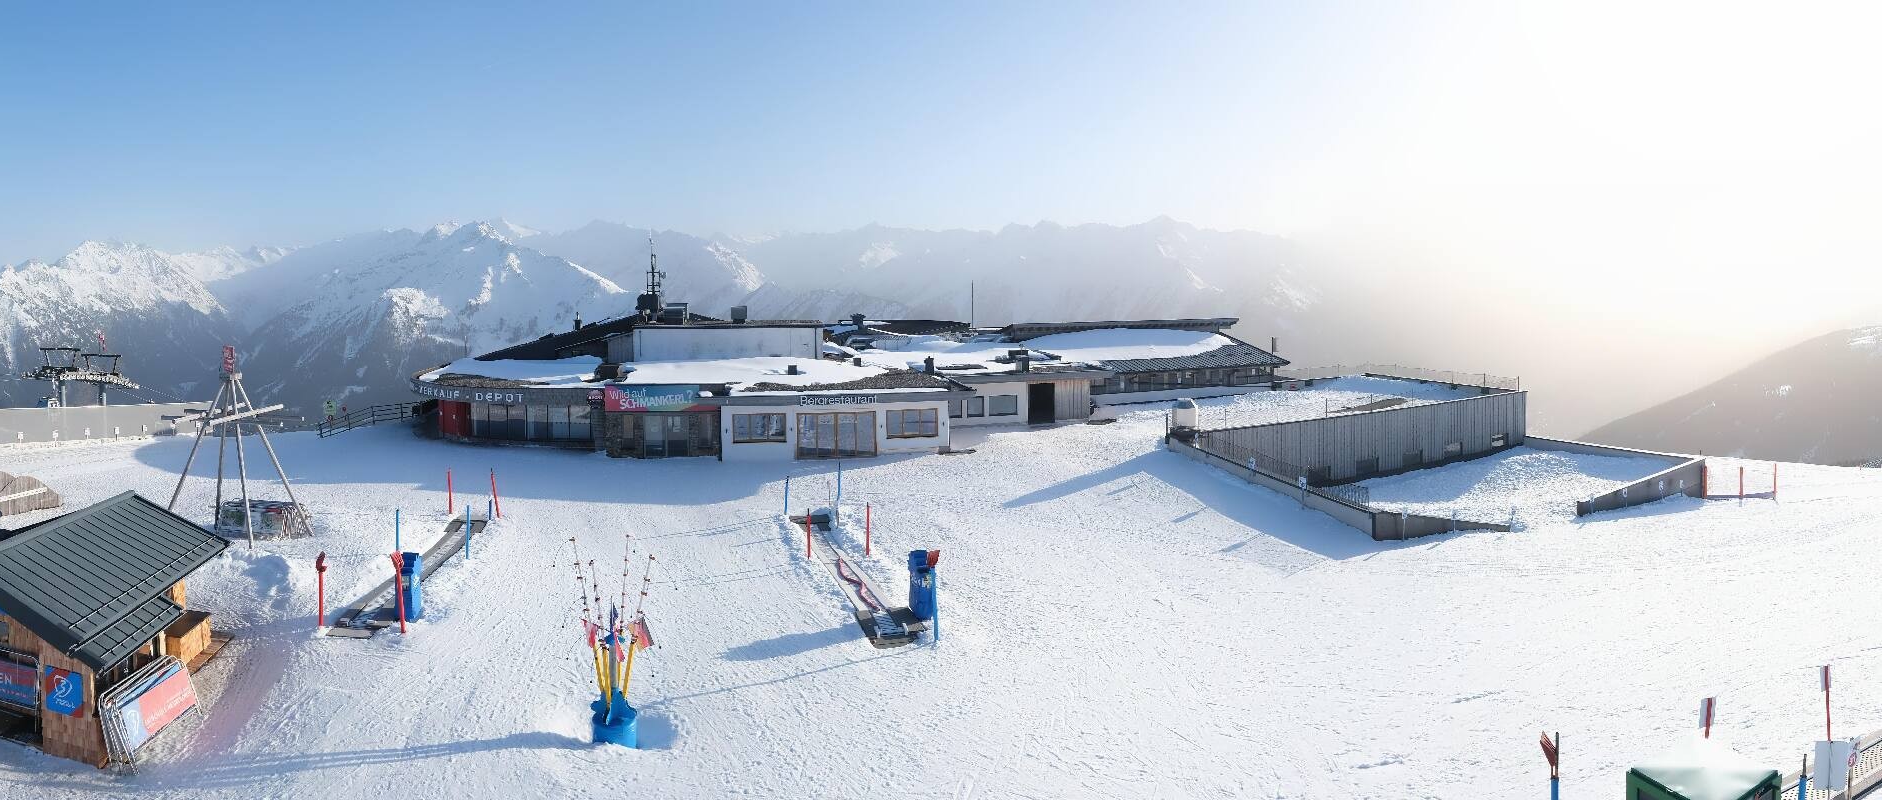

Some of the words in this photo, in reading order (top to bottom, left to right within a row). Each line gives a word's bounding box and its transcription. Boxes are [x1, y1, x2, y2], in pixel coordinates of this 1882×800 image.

[419, 385, 459, 399] VERKAUF
[475, 392, 524, 403] DEPOT
[609, 388, 630, 400] Wild
[631, 387, 648, 398] auf
[619, 390, 693, 410] SCHMANKERL?
[800, 395, 877, 406] Bergrestaurant
